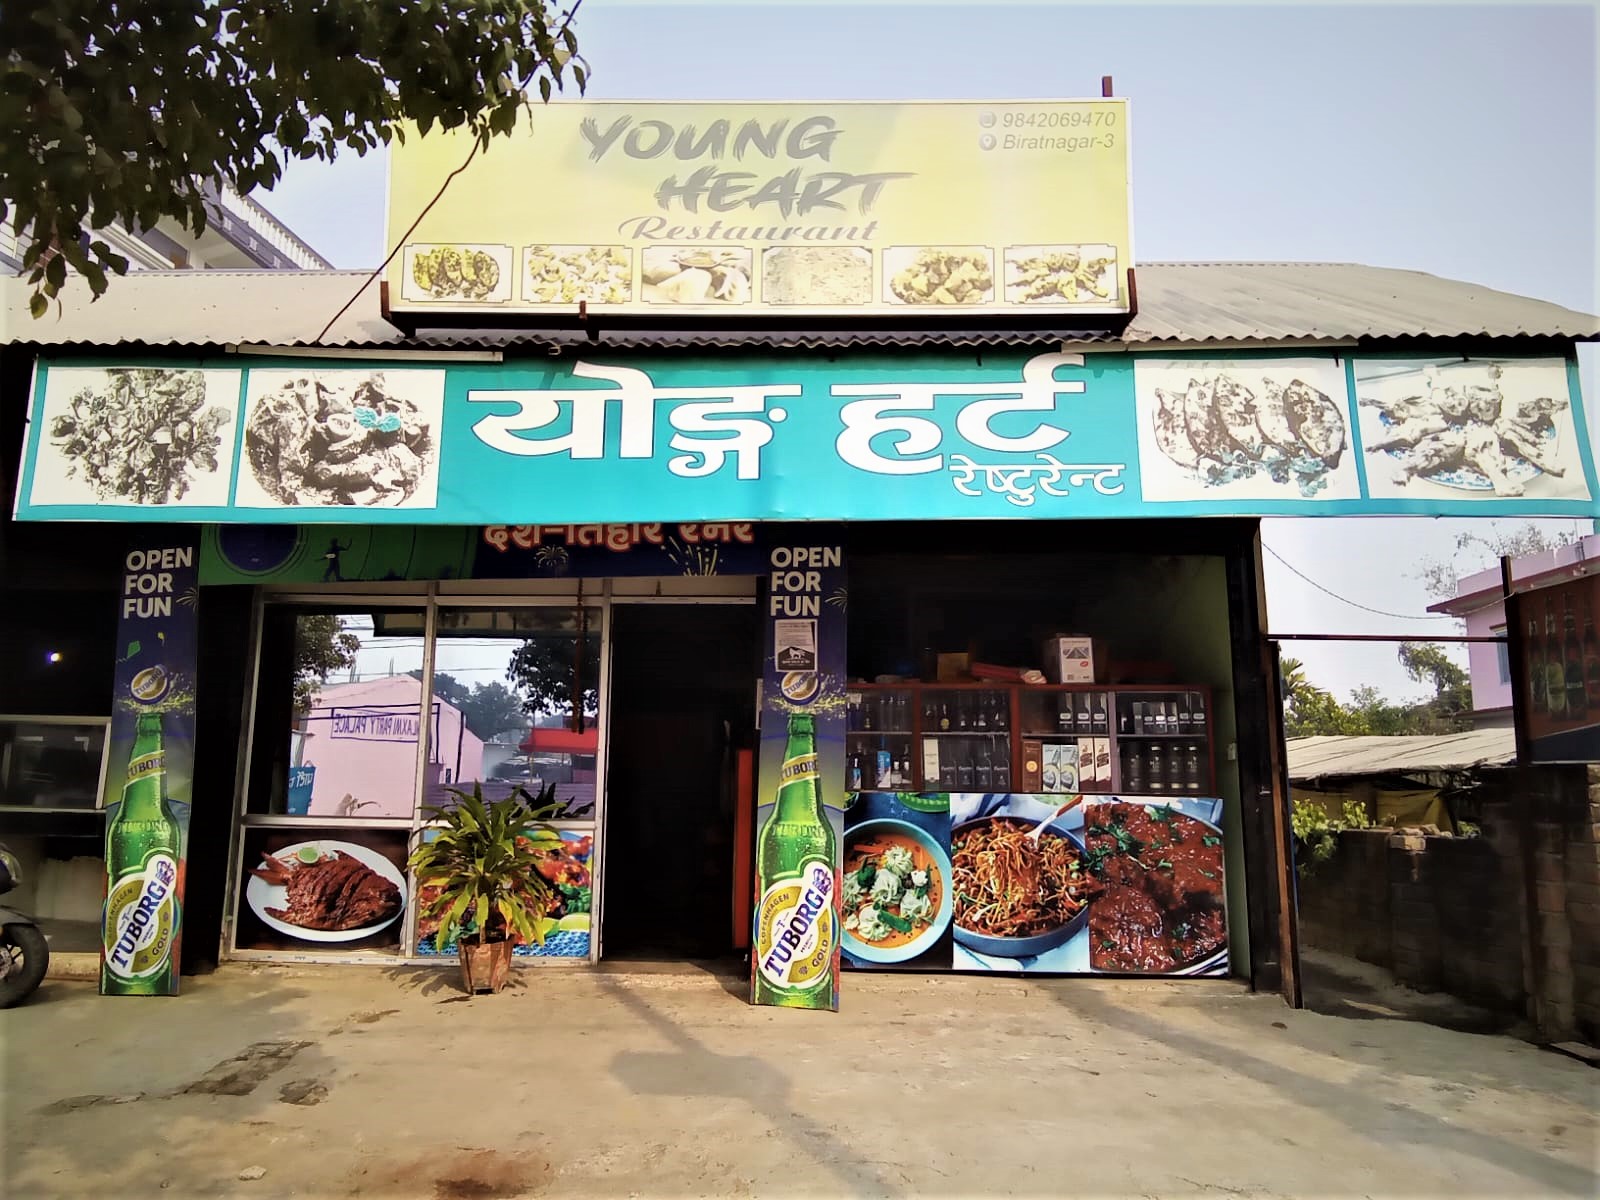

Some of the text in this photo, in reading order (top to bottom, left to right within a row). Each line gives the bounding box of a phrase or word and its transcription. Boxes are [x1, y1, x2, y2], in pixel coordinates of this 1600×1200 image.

[1003, 112, 1116, 127] 9842069470
[580, 115, 845, 162] YOUNG
[1003, 133, 1115, 152] Biratnagar-3
[653, 168, 918, 218] HEART
[618, 214, 879, 241] Restaurant
[829, 353, 1086, 475] हर्ट
[126, 547, 192, 571] OPEN
[770, 547, 841, 568] OPEN
[124, 573, 173, 595] FOR
[771, 571, 821, 592] FOR
[123, 596, 172, 619] FUN
[770, 595, 820, 617] FUN
[110, 880, 168, 969] TUBORG
[761, 893, 790, 945] COPENHAGEN
[764, 887, 826, 977] TUBORG
[152, 927, 169, 957] GOLD
[812, 939, 829, 968] GOLD
